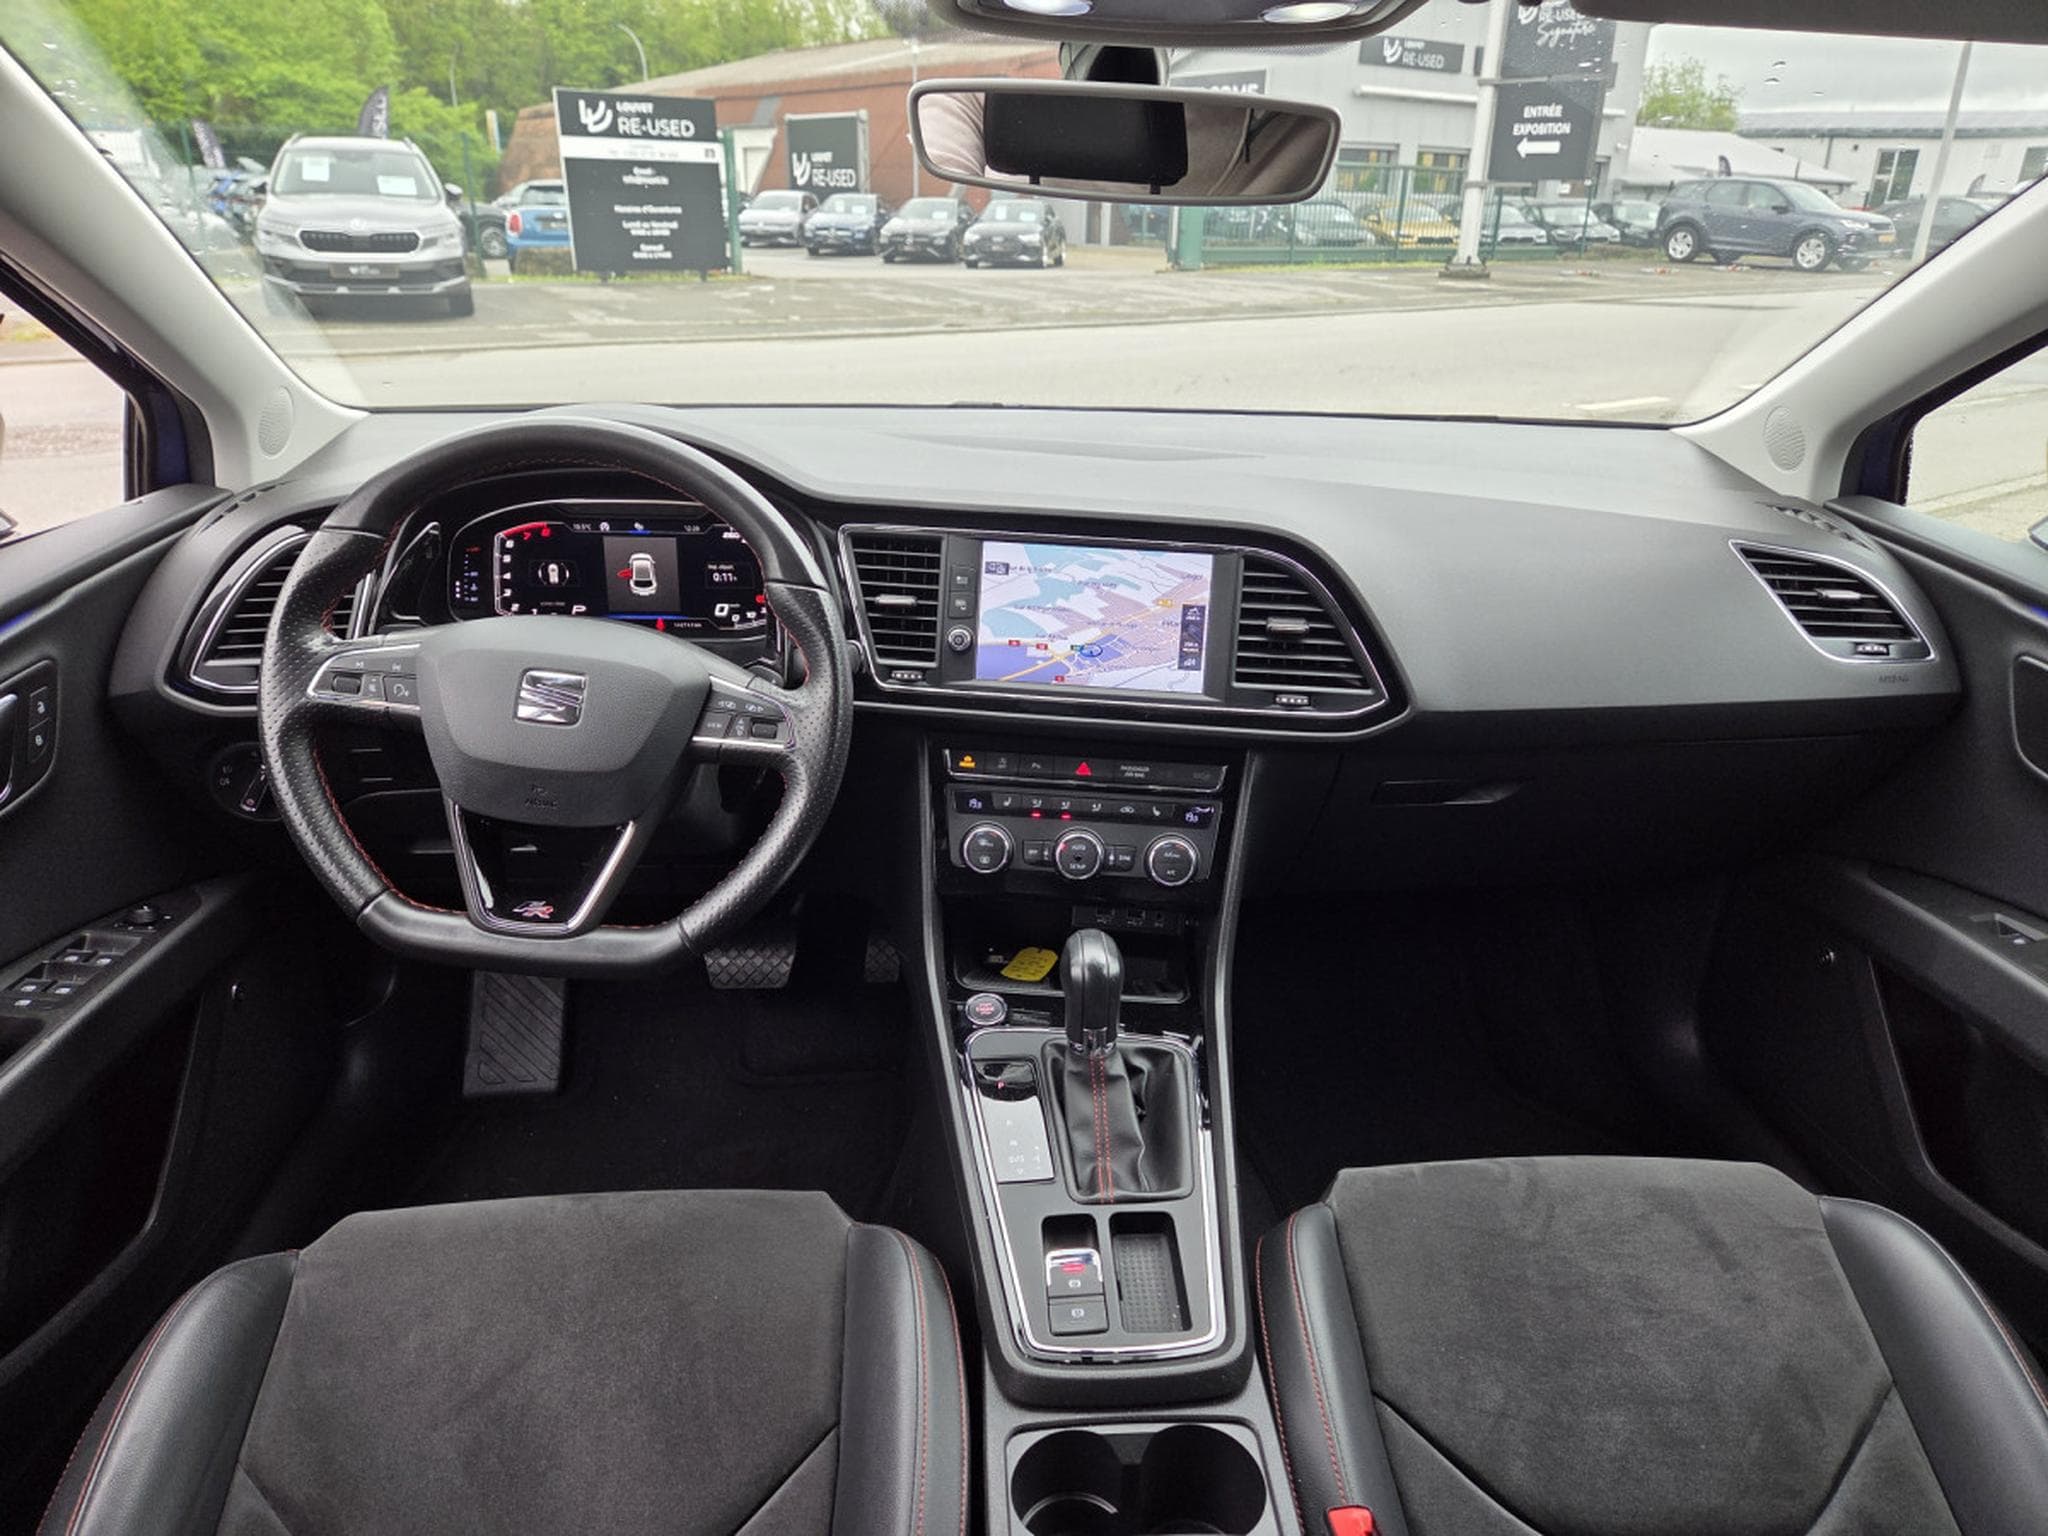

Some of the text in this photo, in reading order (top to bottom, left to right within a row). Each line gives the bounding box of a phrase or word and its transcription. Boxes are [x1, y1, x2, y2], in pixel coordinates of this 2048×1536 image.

[1523, 102, 1563, 118] ENTRÉE
[617, 117, 695, 138] RE-USED
[1513, 122, 1571, 136] EXPOSITION
[571, 604, 587, 615] P
